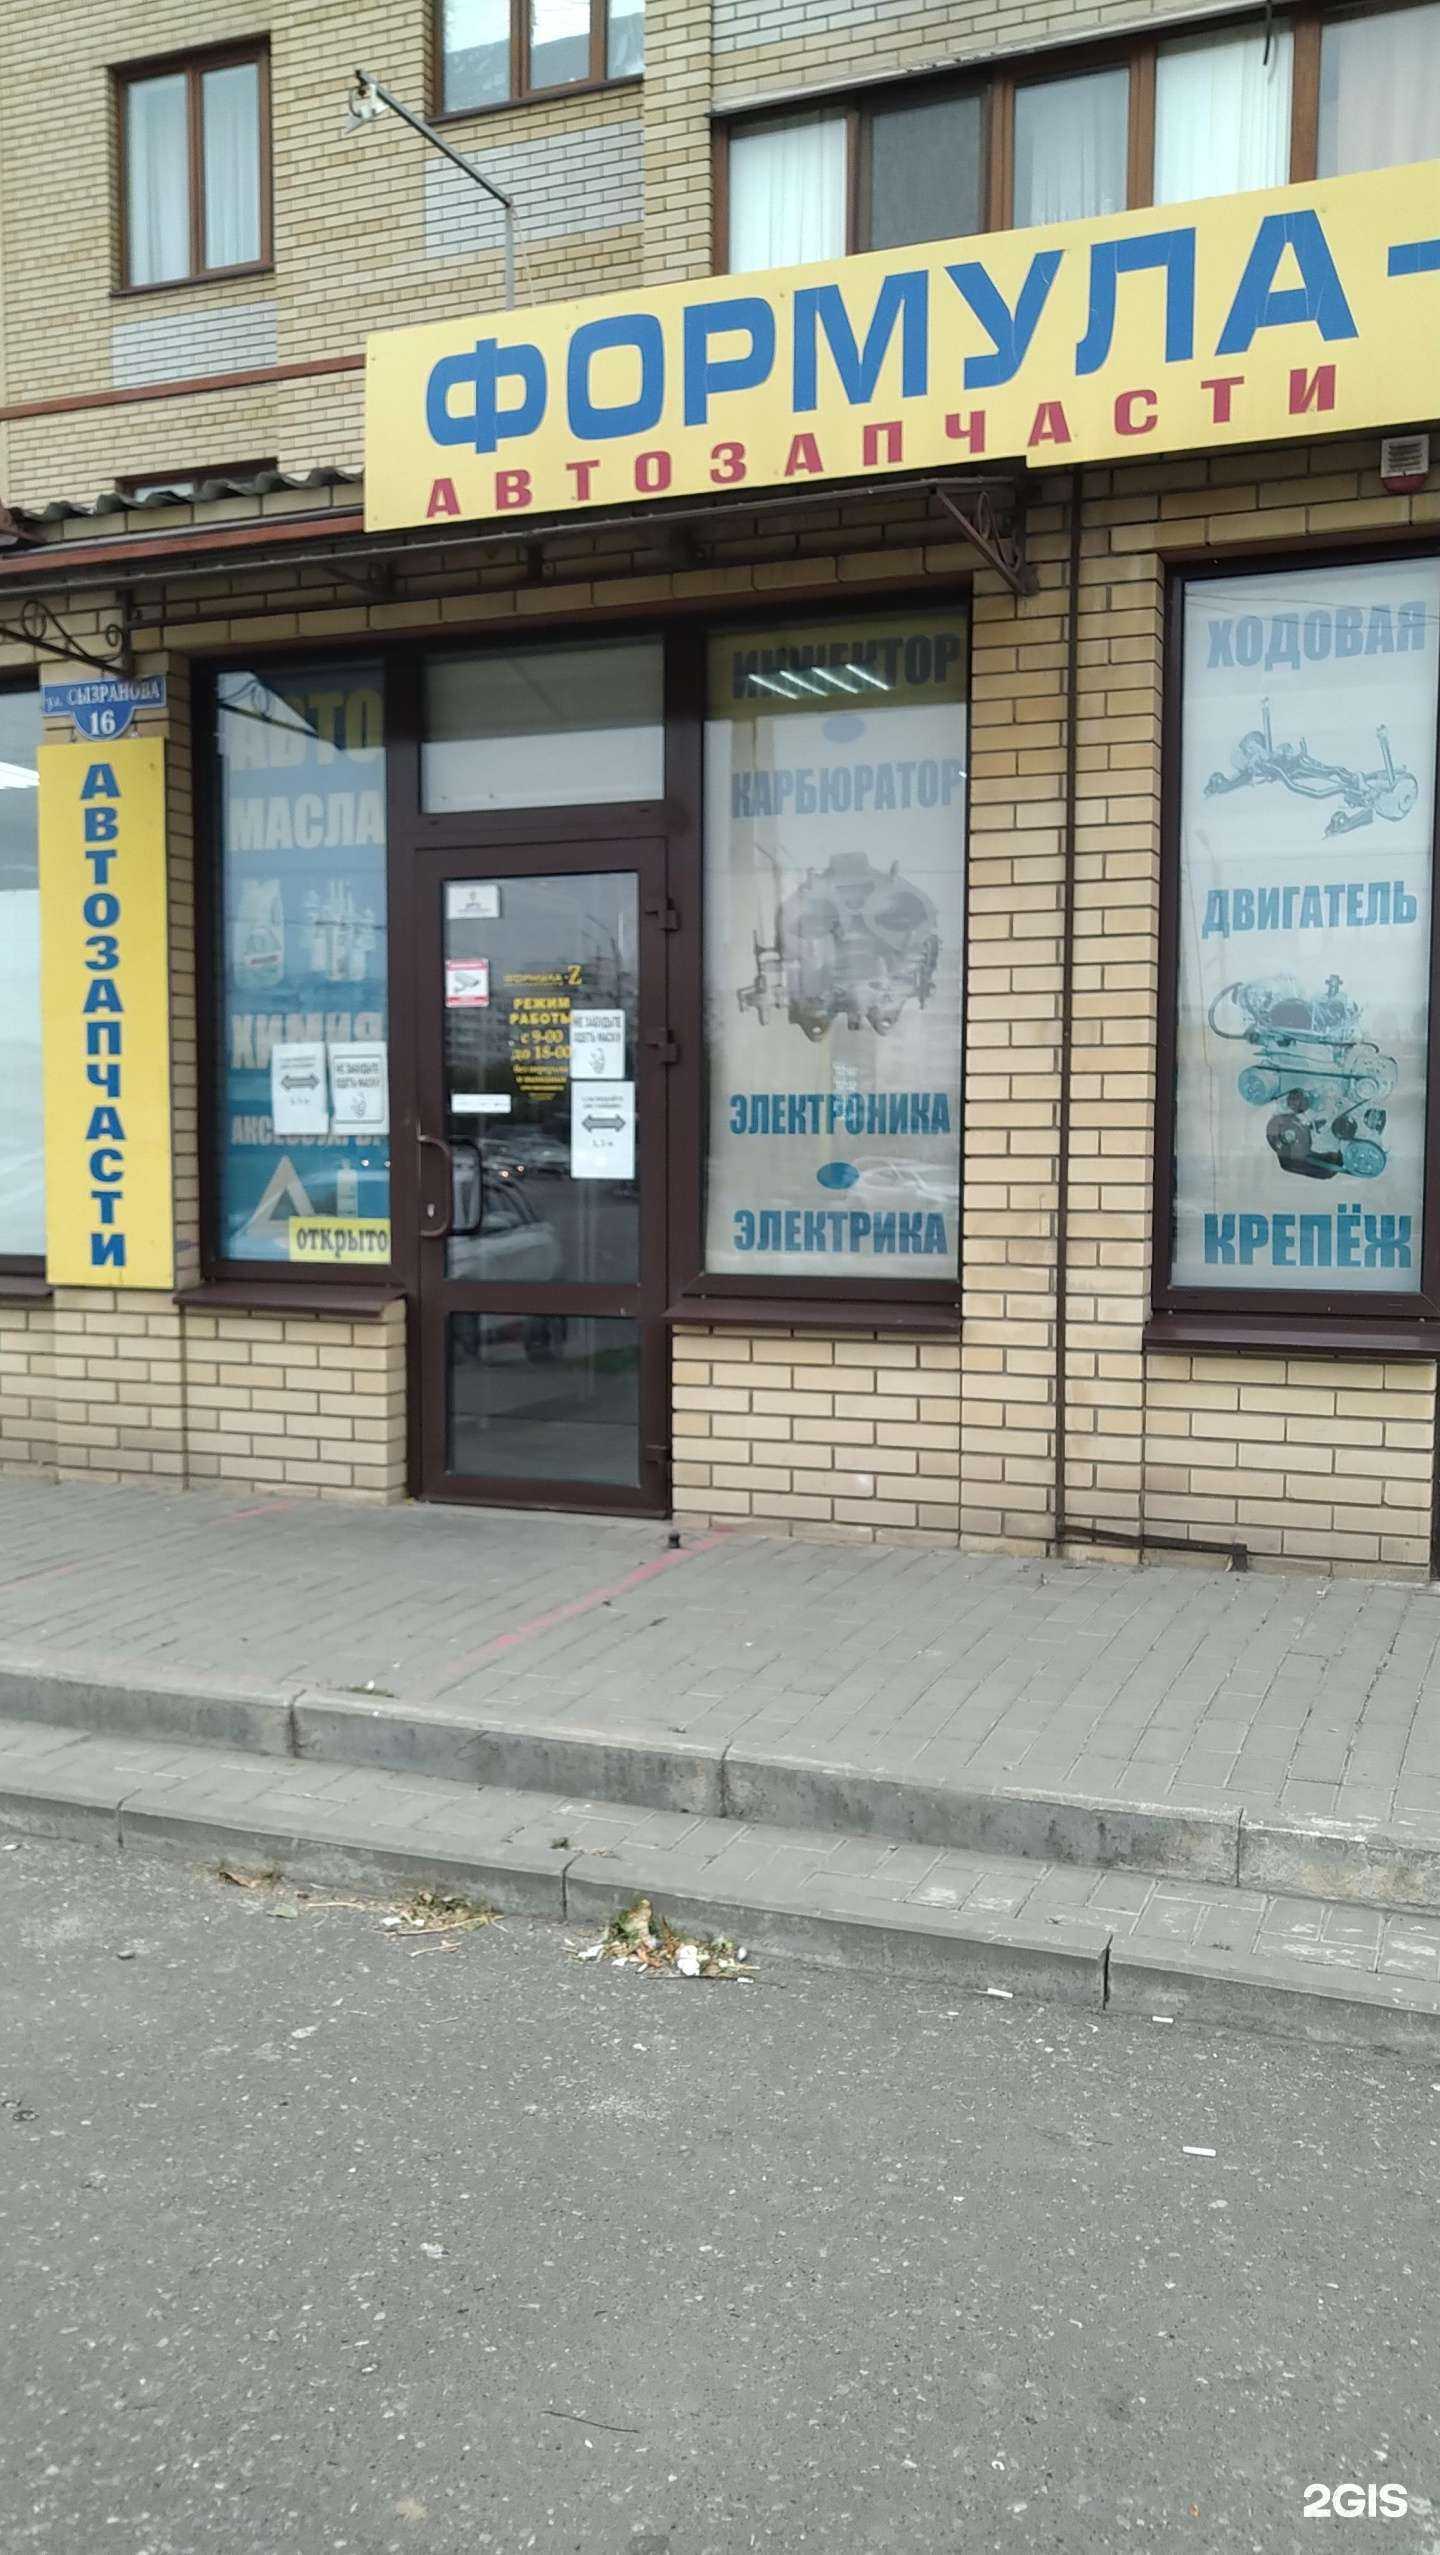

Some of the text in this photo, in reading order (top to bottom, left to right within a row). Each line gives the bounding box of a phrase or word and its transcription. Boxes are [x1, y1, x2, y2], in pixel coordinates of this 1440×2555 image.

[426, 363, 1337, 519] АВТОЗАПЧАСТИ
[1206, 600, 1426, 671] ХОДОВАЯ
[68, 680, 160, 706] СЫЗРАНОВА
[90, 709, 116, 736] 16
[731, 758, 962, 818] КАРБЮРАТОР
[229, 790, 386, 851] МАСЛА
[1202, 881, 1417, 940] ДВИГАТЕЛЬ
[80, 763, 126, 1268] АВТОЗАПЧАСТИ
[730, 1091, 950, 1136] ЭЛЕКТРОНИКА
[733, 1208, 948, 1255] ЭЛЕКТРИКА
[1205, 1204, 1412, 1269] КРЕПЁЖ
